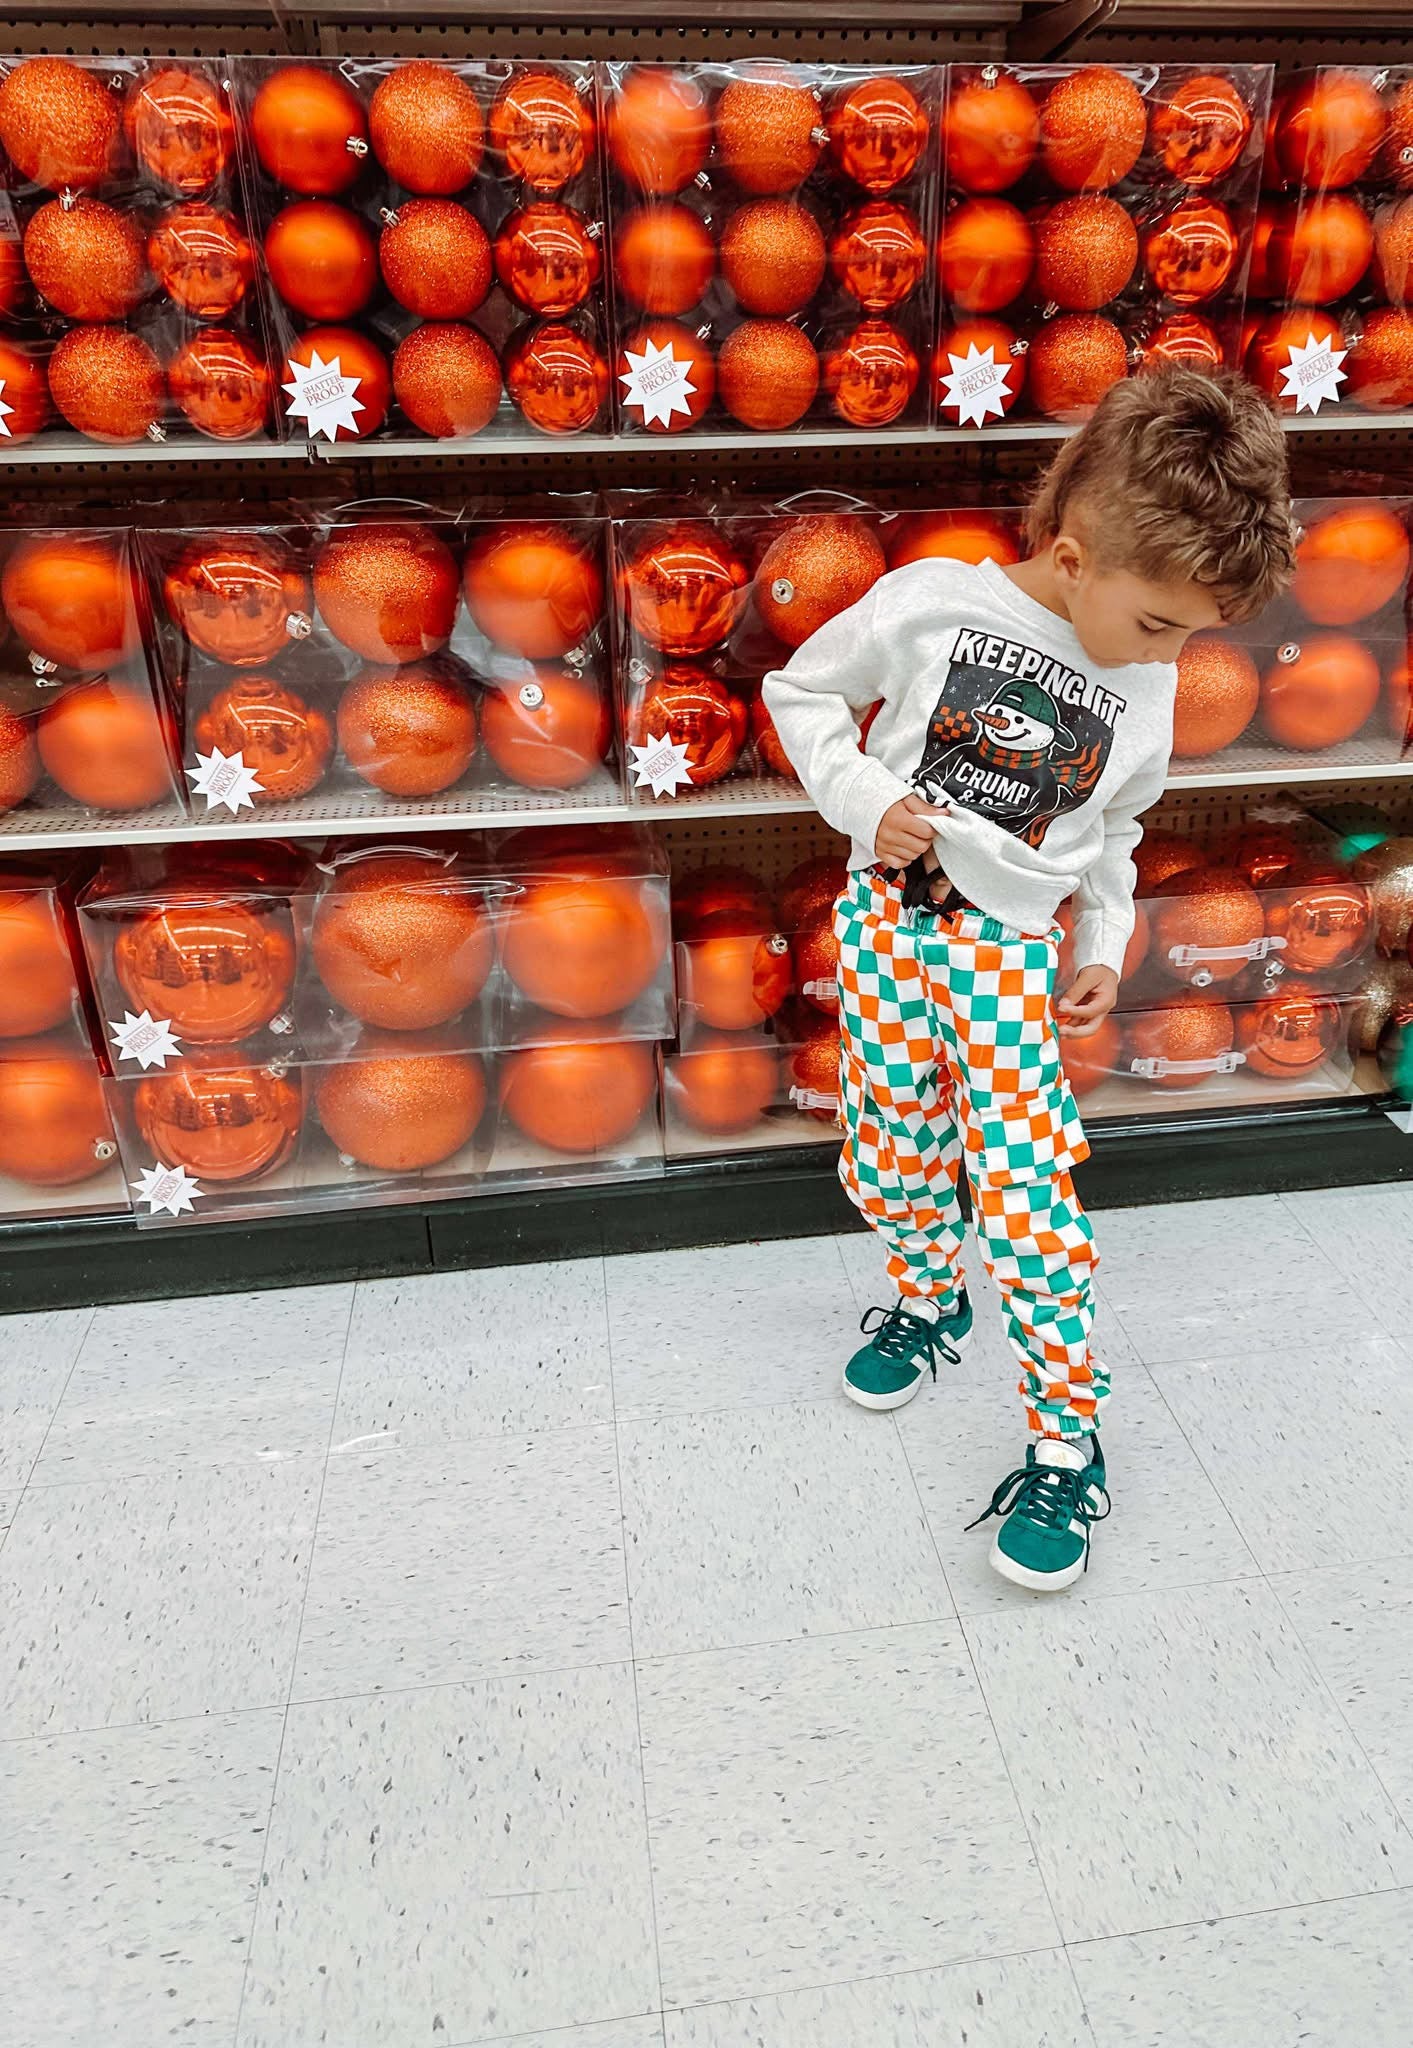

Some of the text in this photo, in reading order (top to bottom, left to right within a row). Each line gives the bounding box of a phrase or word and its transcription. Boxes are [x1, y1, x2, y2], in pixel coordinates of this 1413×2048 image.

[638, 360, 676, 384] SHATTER
[959, 364, 996, 387] SHATTER
[1297, 352, 1333, 376] SHATTER
[1299, 359, 1334, 386] PROOF
[302, 374, 342, 396] SHATTER
[641, 367, 678, 394] PROOF
[961, 371, 998, 397] PROOF
[305, 382, 345, 406] PROOF
[950, 628, 1127, 731] KEEPING IT
[647, 754, 677, 779] PROOF
[213, 767, 239, 797] PROOF
[955, 762, 1031, 805] CRUMP
